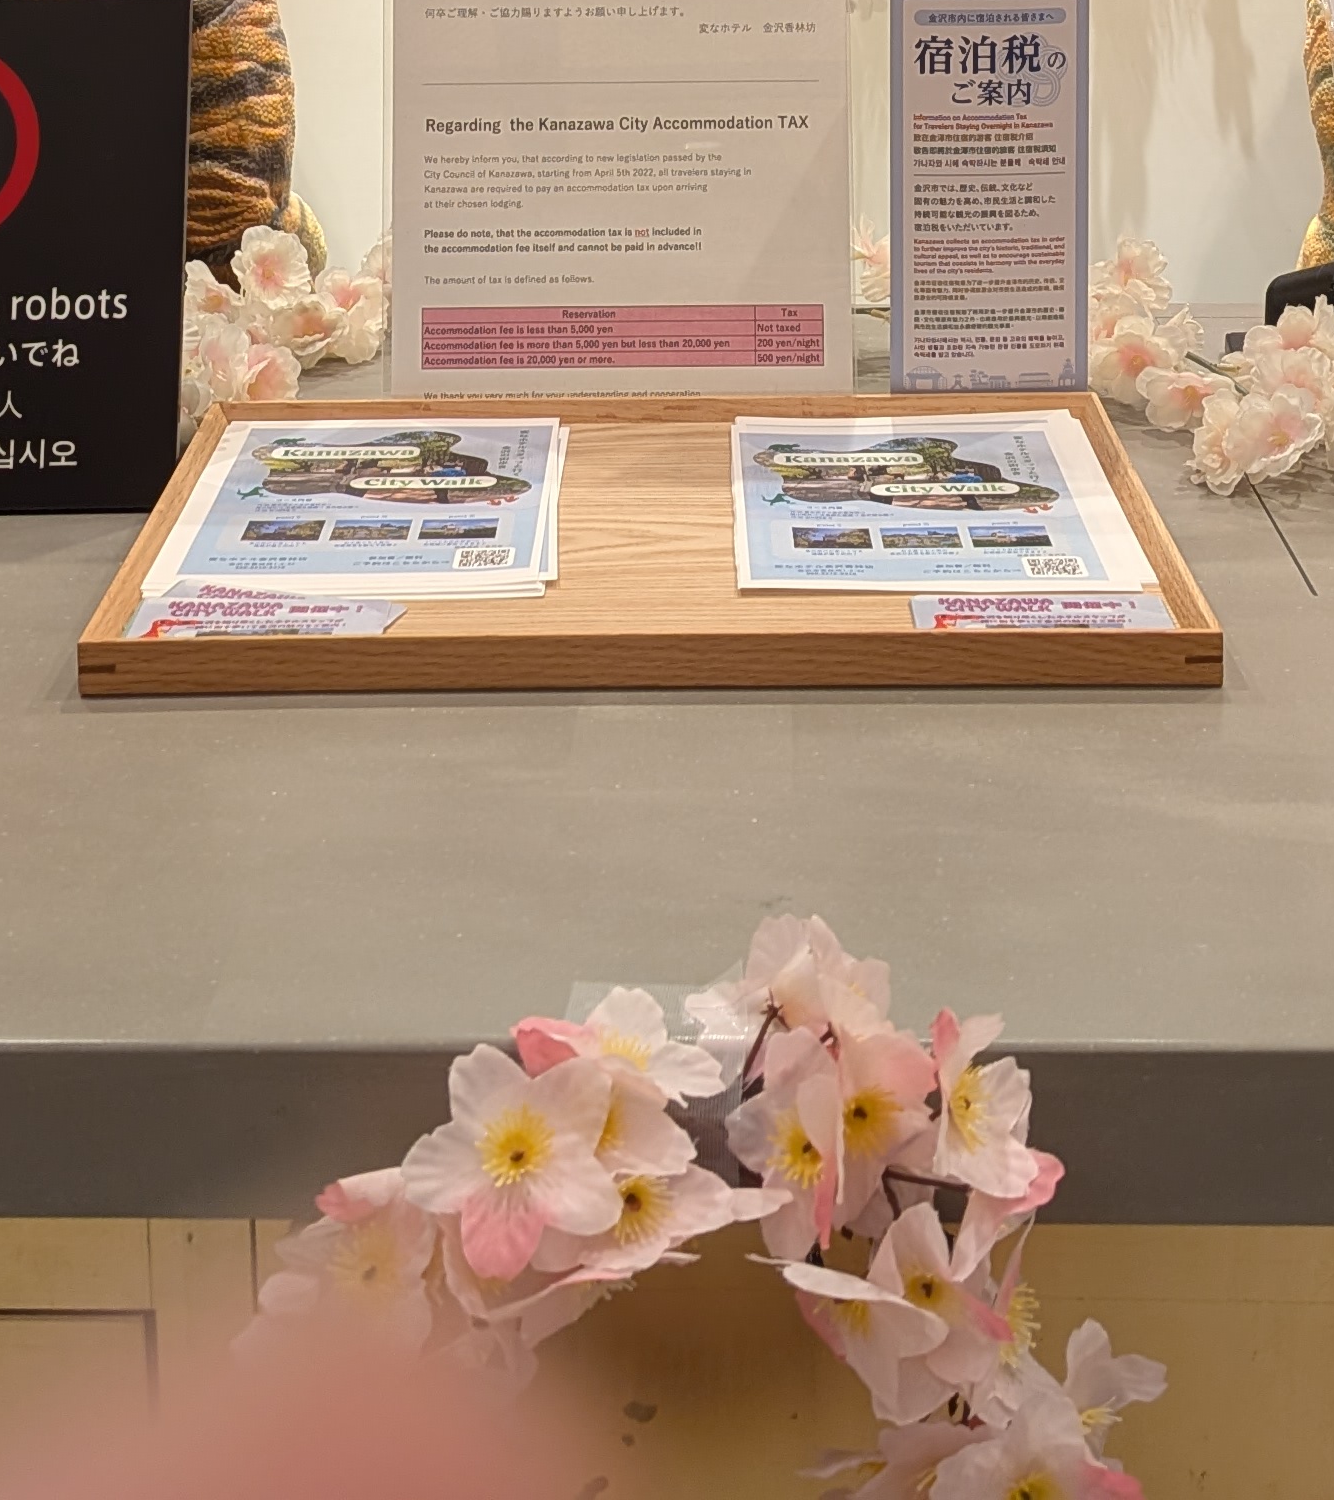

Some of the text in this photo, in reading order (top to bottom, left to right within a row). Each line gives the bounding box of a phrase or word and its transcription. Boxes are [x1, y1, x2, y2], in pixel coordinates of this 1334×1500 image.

[929, 13, 1054, 23] 金沢市内に宿泊される皆さまへ
[699, 23, 752, 33] 変なホテル
[914, 34, 1066, 75] 宿泊税の
[951, 79, 1032, 106] ご案内
[426, 115, 808, 134] Regarding the Kanazawa City Accommodation TAX
[424, 226, 701, 238] Please do note, that the accommodation tax is not included in
[11, 287, 127, 320] robots
[562, 309, 615, 318] Reservation
[781, 308, 797, 316] Tax
[757, 323, 801, 333] Not taxed
[757, 338, 820, 349] 200 yen/night
[757, 353, 820, 364] 500 yen/night
[279, 446, 417, 460] Kanazawa
[784, 453, 921, 465] Kanazawa
[364, 476, 484, 488] City Walk
[884, 482, 1008, 496] City Walk
